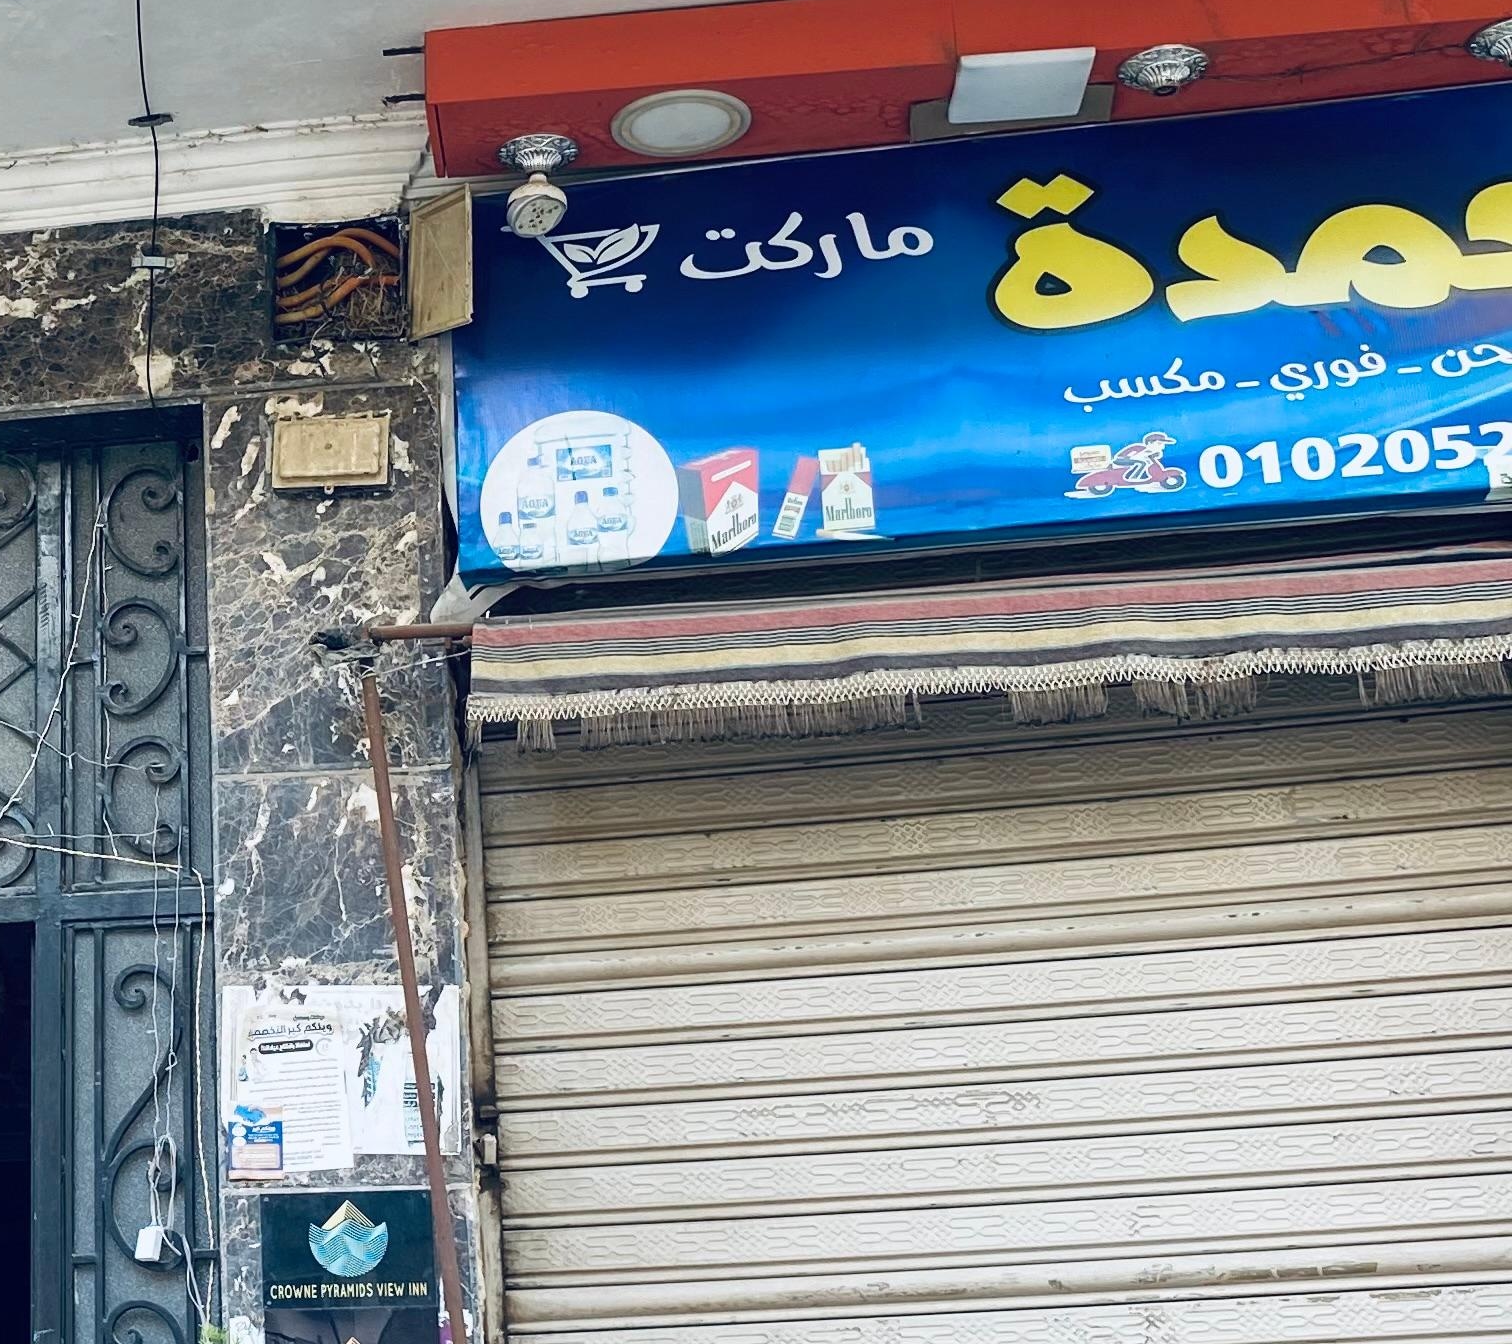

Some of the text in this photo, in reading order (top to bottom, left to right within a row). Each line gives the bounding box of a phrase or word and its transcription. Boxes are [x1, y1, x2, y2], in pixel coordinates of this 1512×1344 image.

[679, 211, 935, 280] ماركت
[1063, 343, 1512, 413] حن فوري مكسب
[825, 498, 872, 522] Marlboro
[711, 511, 757, 553] Marlboro
[270, 1281, 428, 1300] CROWNE PYRAMIDS VIEW INN
